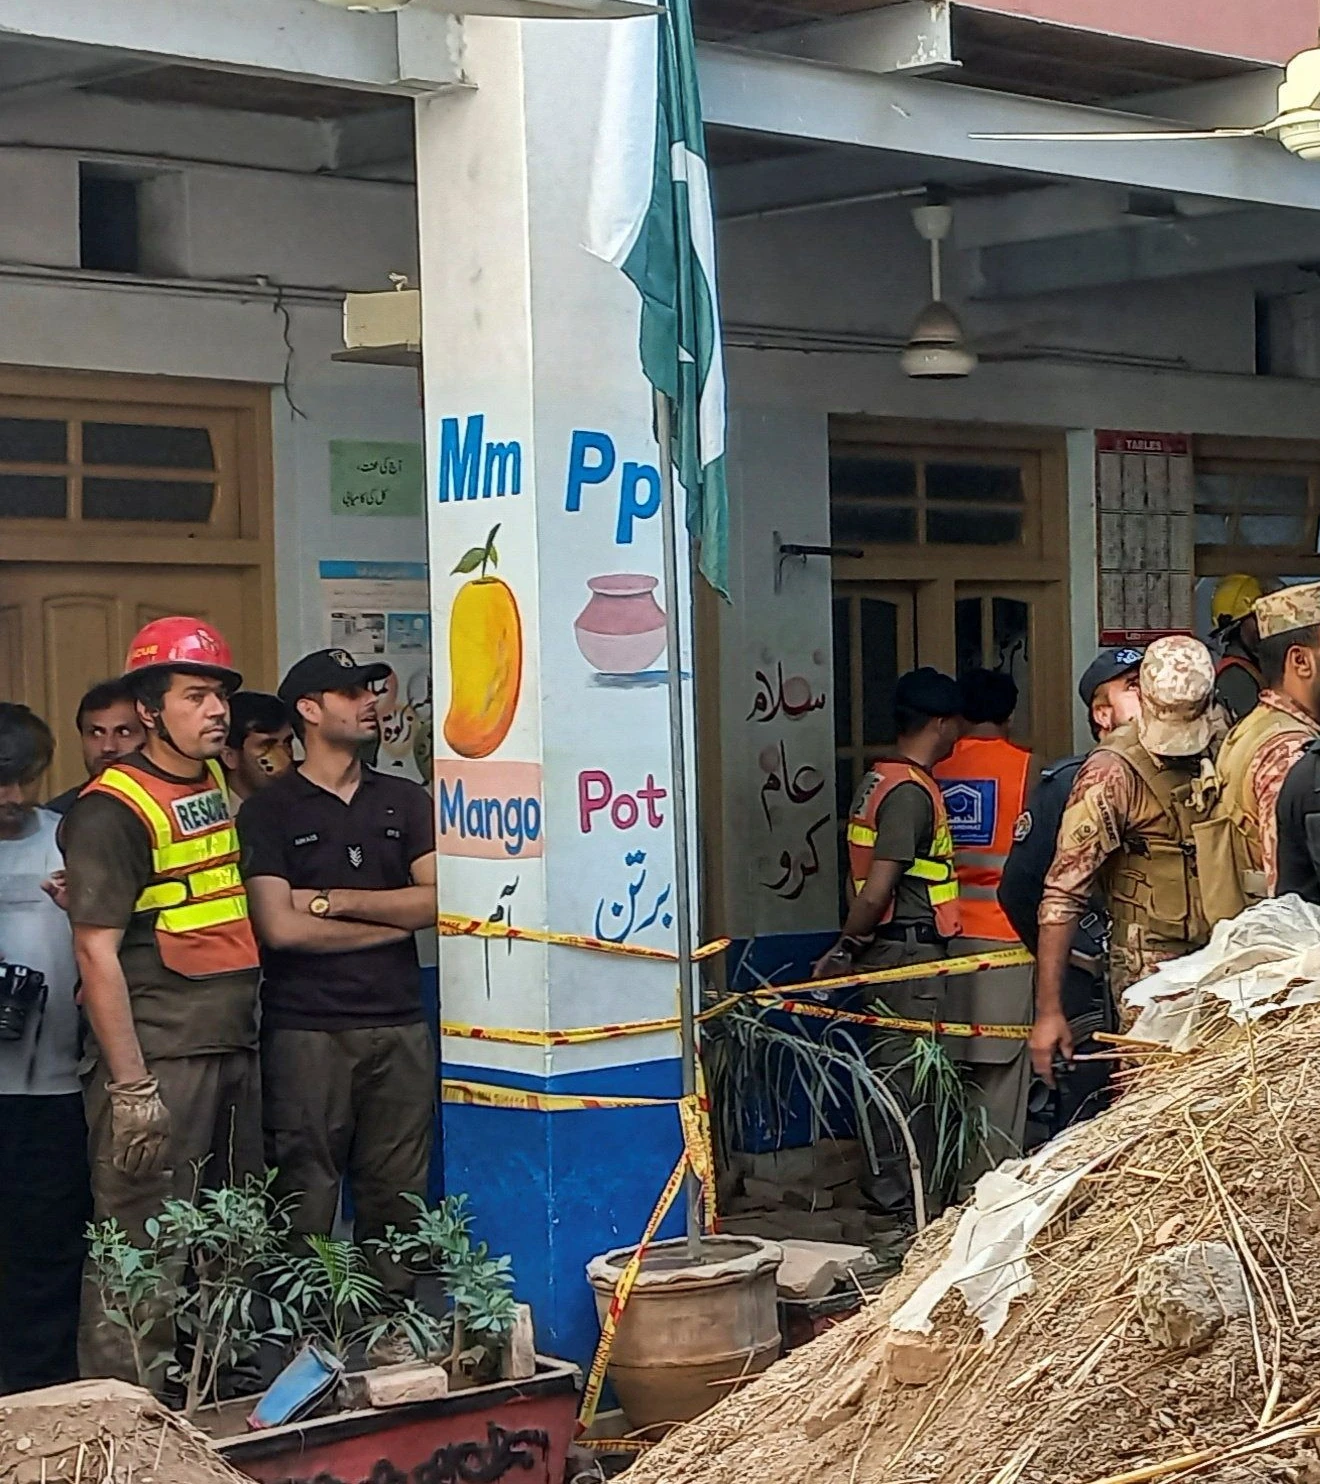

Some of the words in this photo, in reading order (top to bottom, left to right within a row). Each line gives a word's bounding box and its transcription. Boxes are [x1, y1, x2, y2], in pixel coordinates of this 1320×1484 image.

[439, 414, 521, 503] Mm
[565, 430, 662, 544] Pp
[1125, 439, 1162, 451] TABLES
[439, 778, 541, 855] Mango
[578, 770, 668, 833] Pot
[760, 739, 825, 833] عام
[593, 850, 673, 944] برتن
[759, 813, 831, 900] کرو
